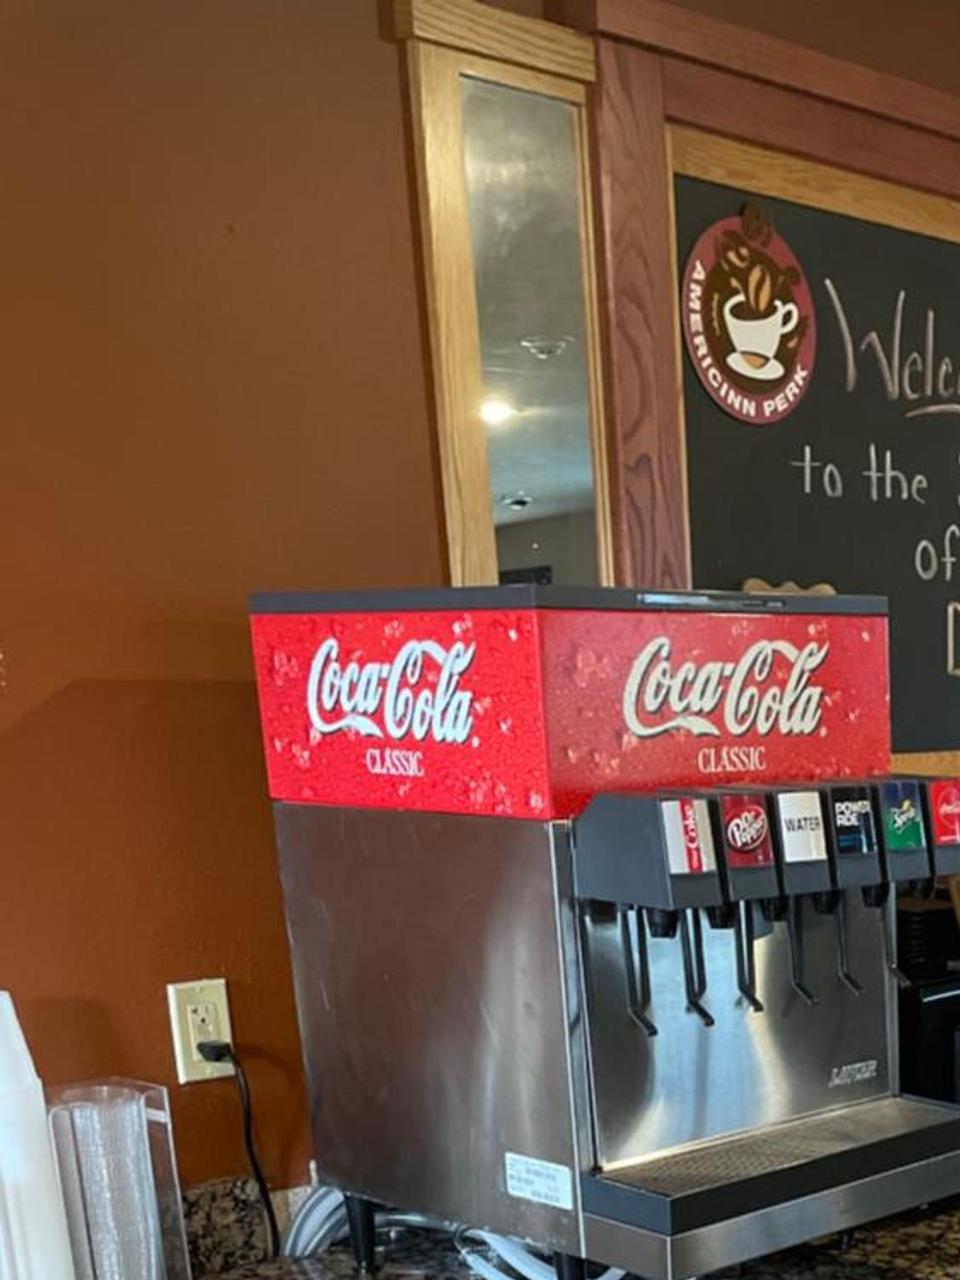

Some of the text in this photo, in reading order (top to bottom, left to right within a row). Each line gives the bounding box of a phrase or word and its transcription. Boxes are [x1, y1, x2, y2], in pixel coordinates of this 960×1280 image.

[688, 260, 808, 417] AMERICINN PERK
[791, 445, 843, 498] to
[862, 443, 928, 504] the
[915, 524, 960, 581] of
[307, 637, 476, 743] Coca-Cola
[623, 636, 829, 736] Coca-Cola
[366, 748, 424, 776] CLASSIC
[698, 746, 766, 773] CLASSIC
[785, 816, 820, 833] WATER
